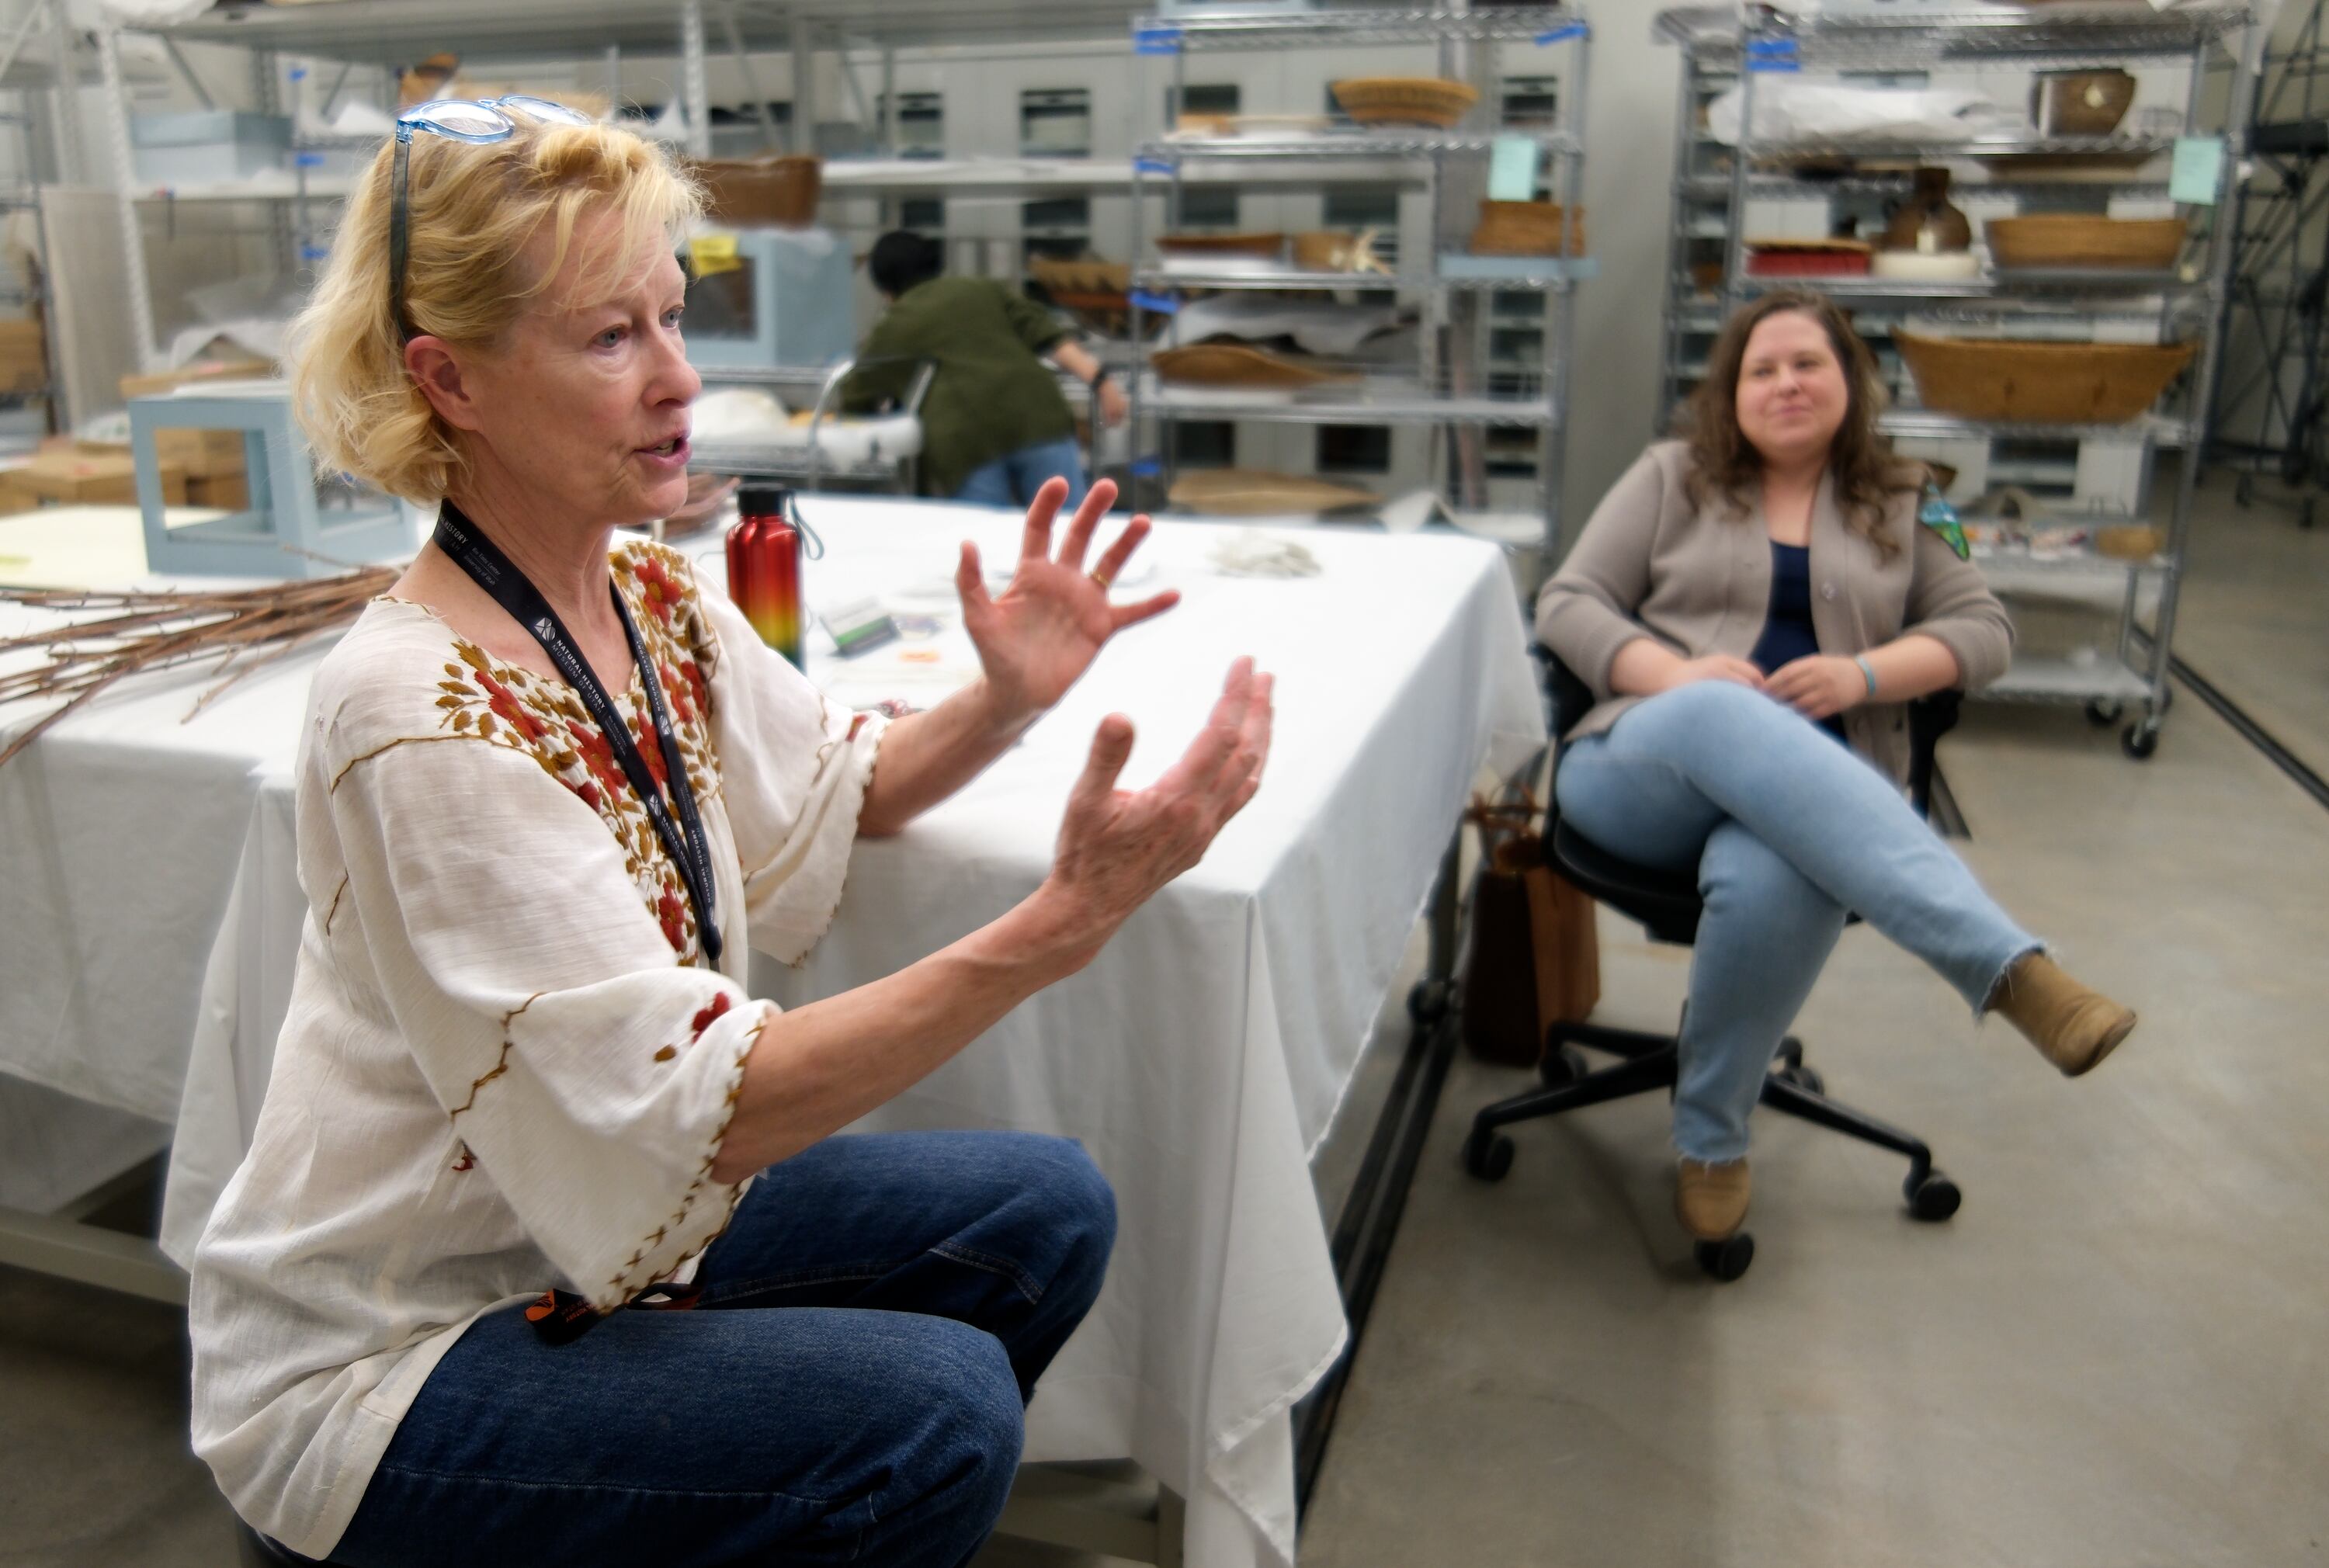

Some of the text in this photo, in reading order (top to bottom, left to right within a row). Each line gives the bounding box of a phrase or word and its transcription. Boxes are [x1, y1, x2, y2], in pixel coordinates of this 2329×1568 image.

[552, 644, 578, 678] MUSEUM
[586, 692, 602, 714] UTAH
[557, 640, 606, 709] NATURAL HISTORY
[662, 816, 680, 850] NATURAL
[691, 829, 711, 903] NATURAL HISTORY
